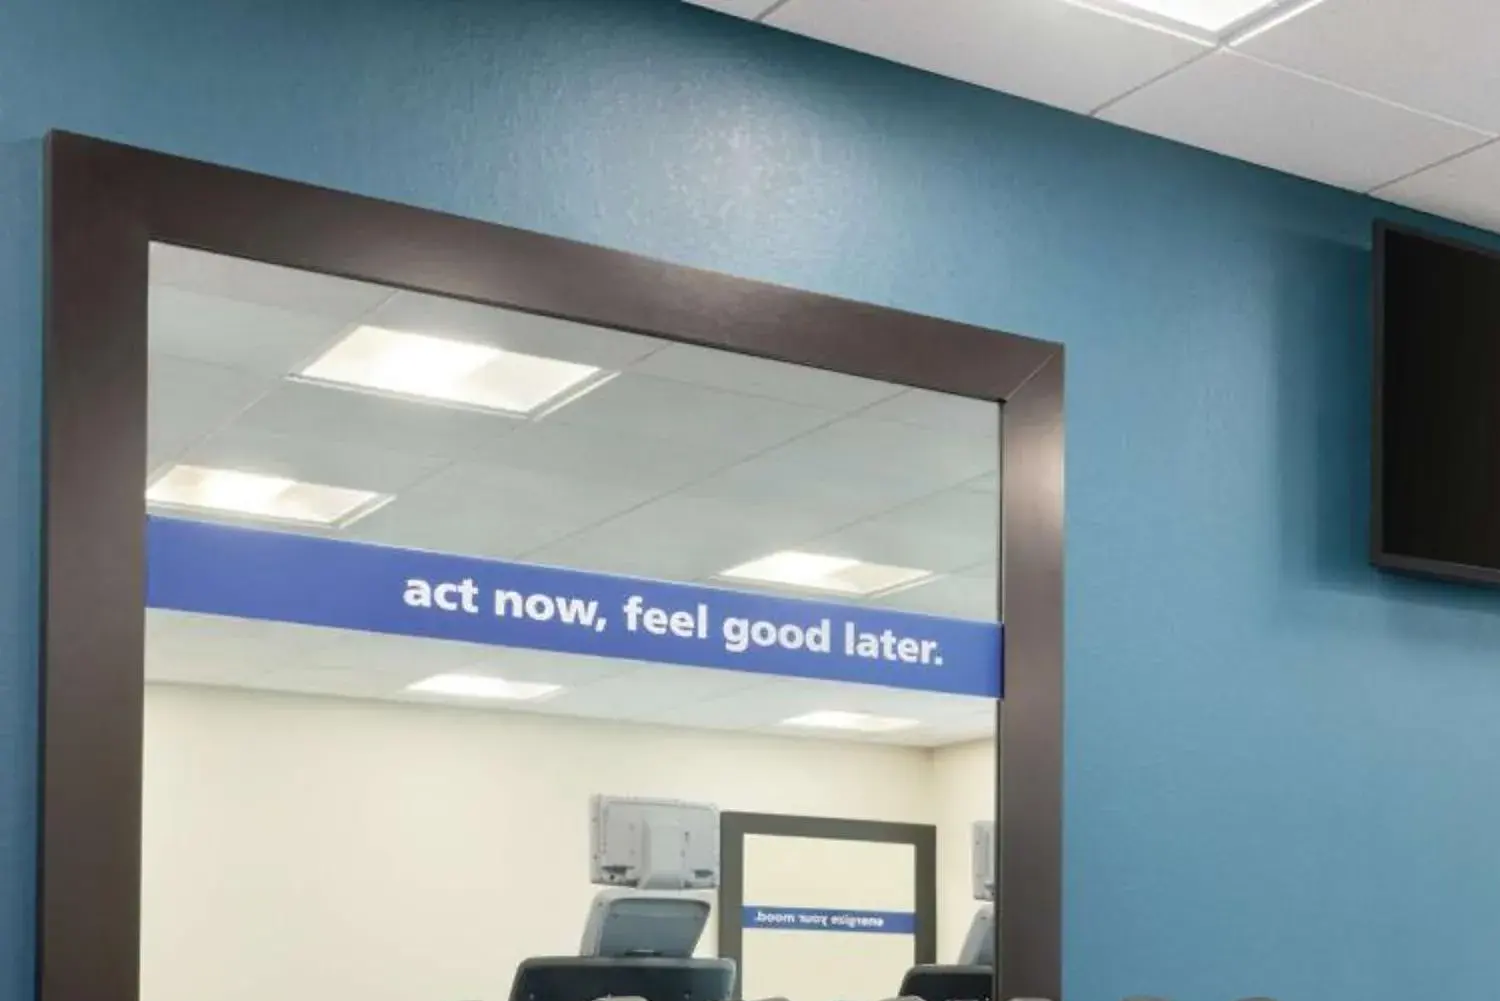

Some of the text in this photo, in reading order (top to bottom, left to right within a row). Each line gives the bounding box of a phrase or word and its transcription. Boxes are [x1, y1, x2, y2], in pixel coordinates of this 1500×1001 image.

[402, 578, 944, 666] act now, feel good later.
